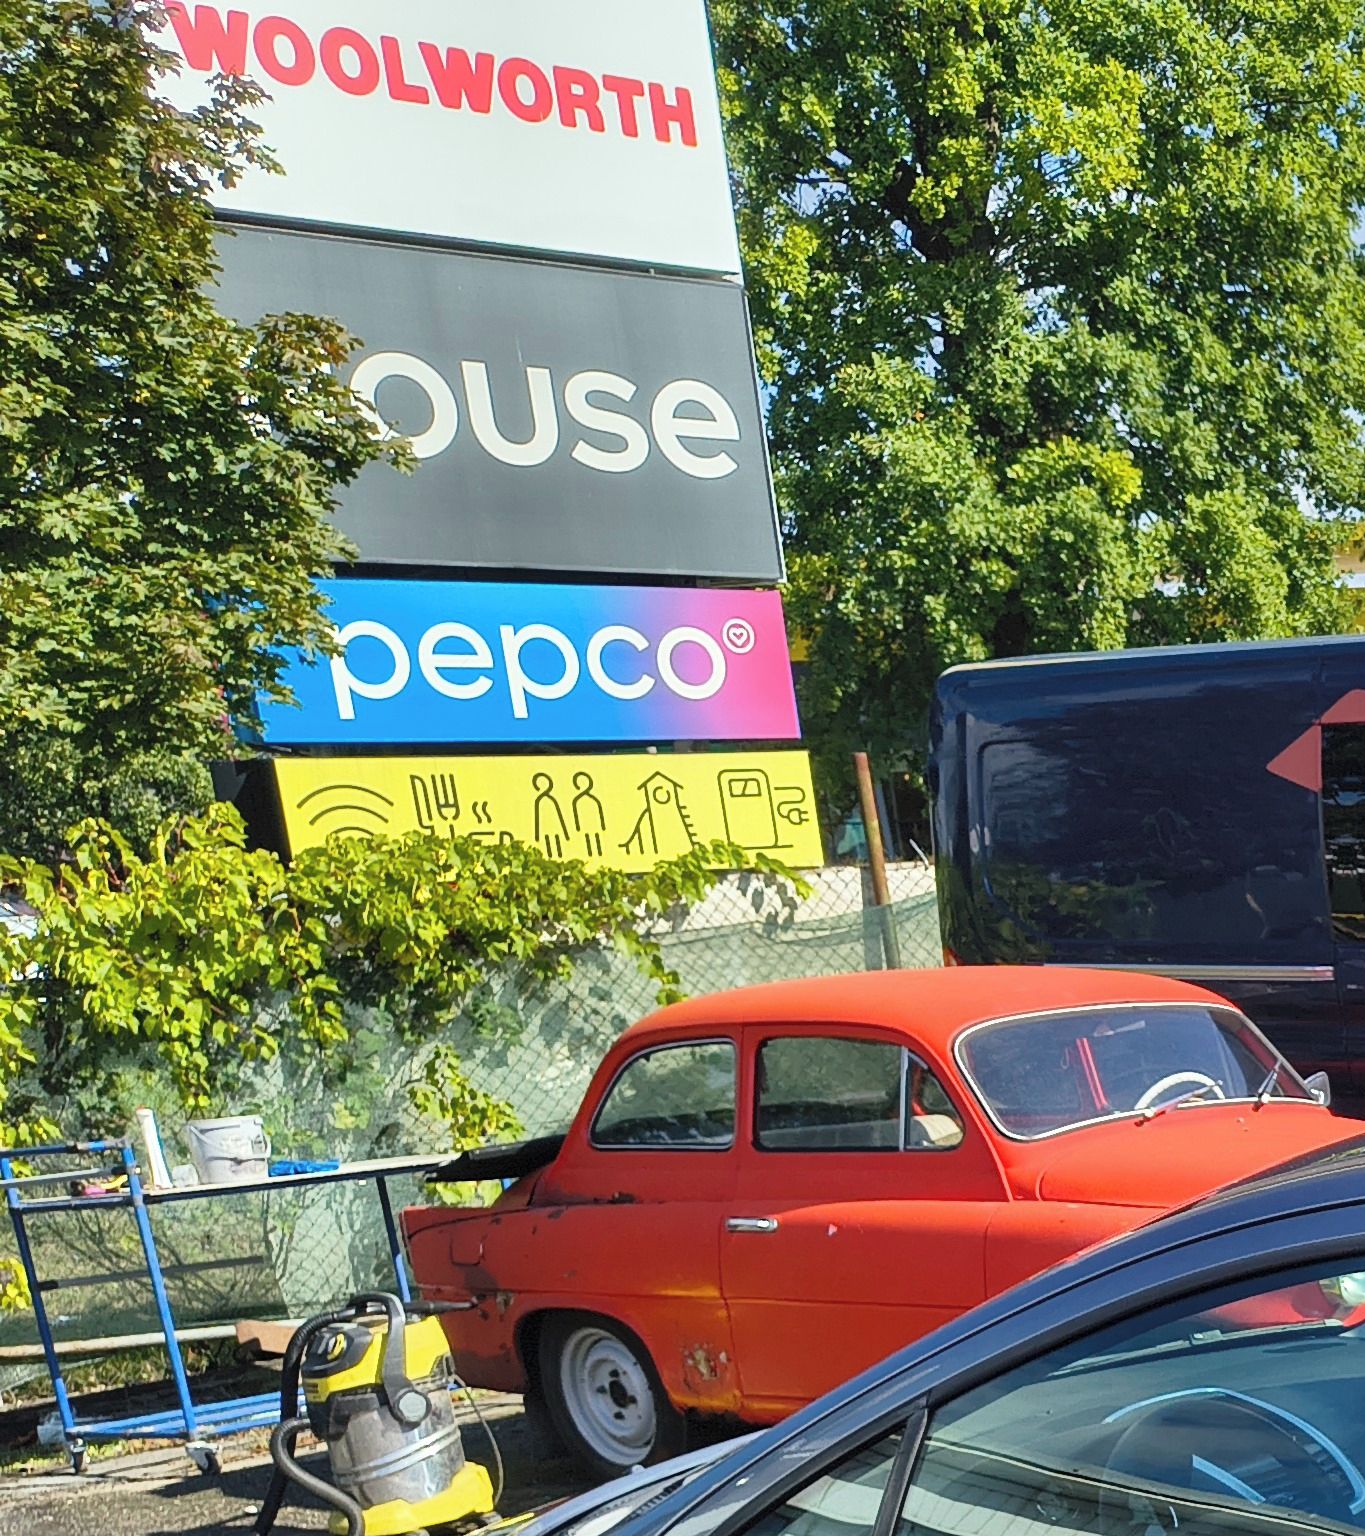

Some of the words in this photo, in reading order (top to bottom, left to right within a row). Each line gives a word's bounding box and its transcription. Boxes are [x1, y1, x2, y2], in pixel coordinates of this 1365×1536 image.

[163, 0, 698, 148] WOOLWORTH
[322, 350, 740, 480] ouse
[328, 619, 727, 720] pepco
